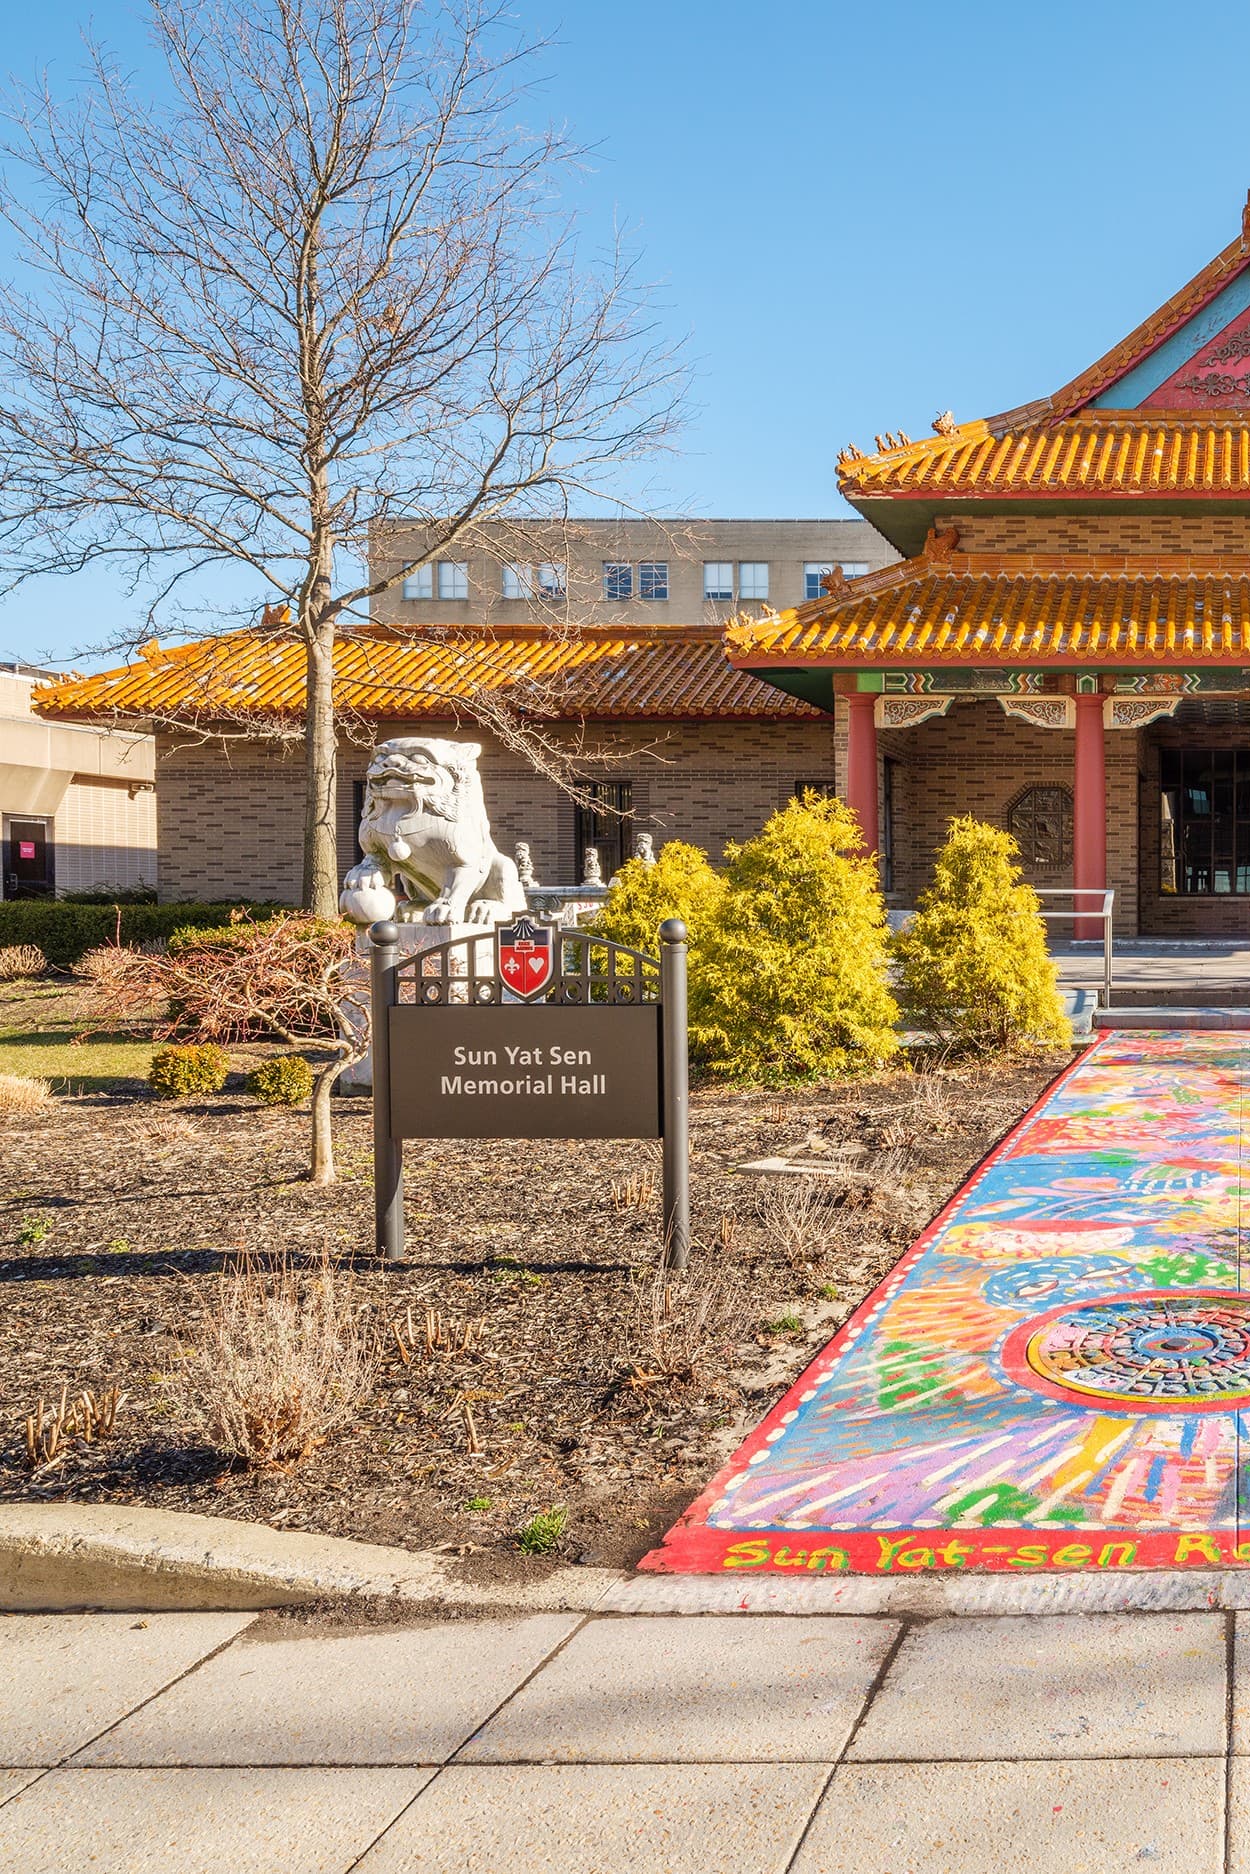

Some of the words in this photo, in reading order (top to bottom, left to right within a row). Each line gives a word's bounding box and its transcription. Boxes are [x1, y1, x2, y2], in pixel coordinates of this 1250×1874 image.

[454, 1046, 497, 1065] Sun
[504, 1046, 543, 1065] Yat
[549, 1046, 592, 1065] Sen
[441, 1074, 552, 1095] Memorial
[561, 1074, 606, 1095] Hall
[723, 1540, 851, 1570] Sun
[876, 1535, 1137, 1570] Yat-sen
